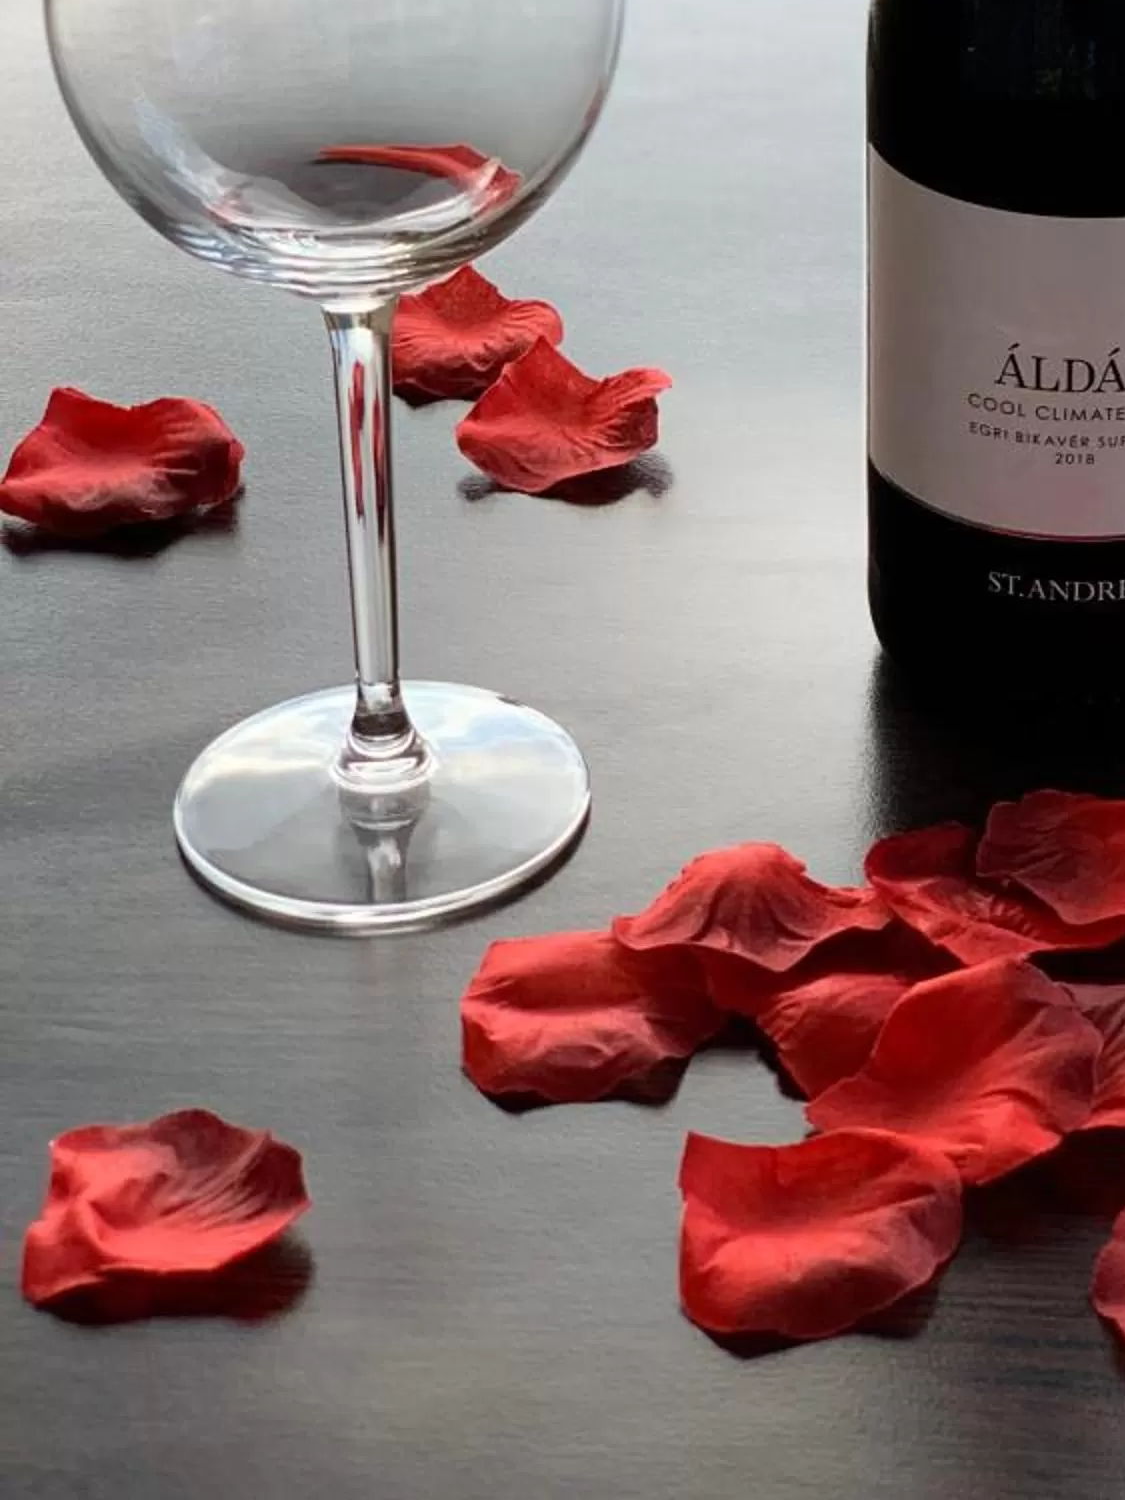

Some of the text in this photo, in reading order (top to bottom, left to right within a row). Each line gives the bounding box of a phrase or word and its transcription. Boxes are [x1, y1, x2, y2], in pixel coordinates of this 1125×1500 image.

[967, 393, 1026, 418] COOL
[968, 421, 1008, 440] EGRI
[1015, 432, 1090, 449] BIKAVÉR
[1055, 452, 1095, 466] 2018
